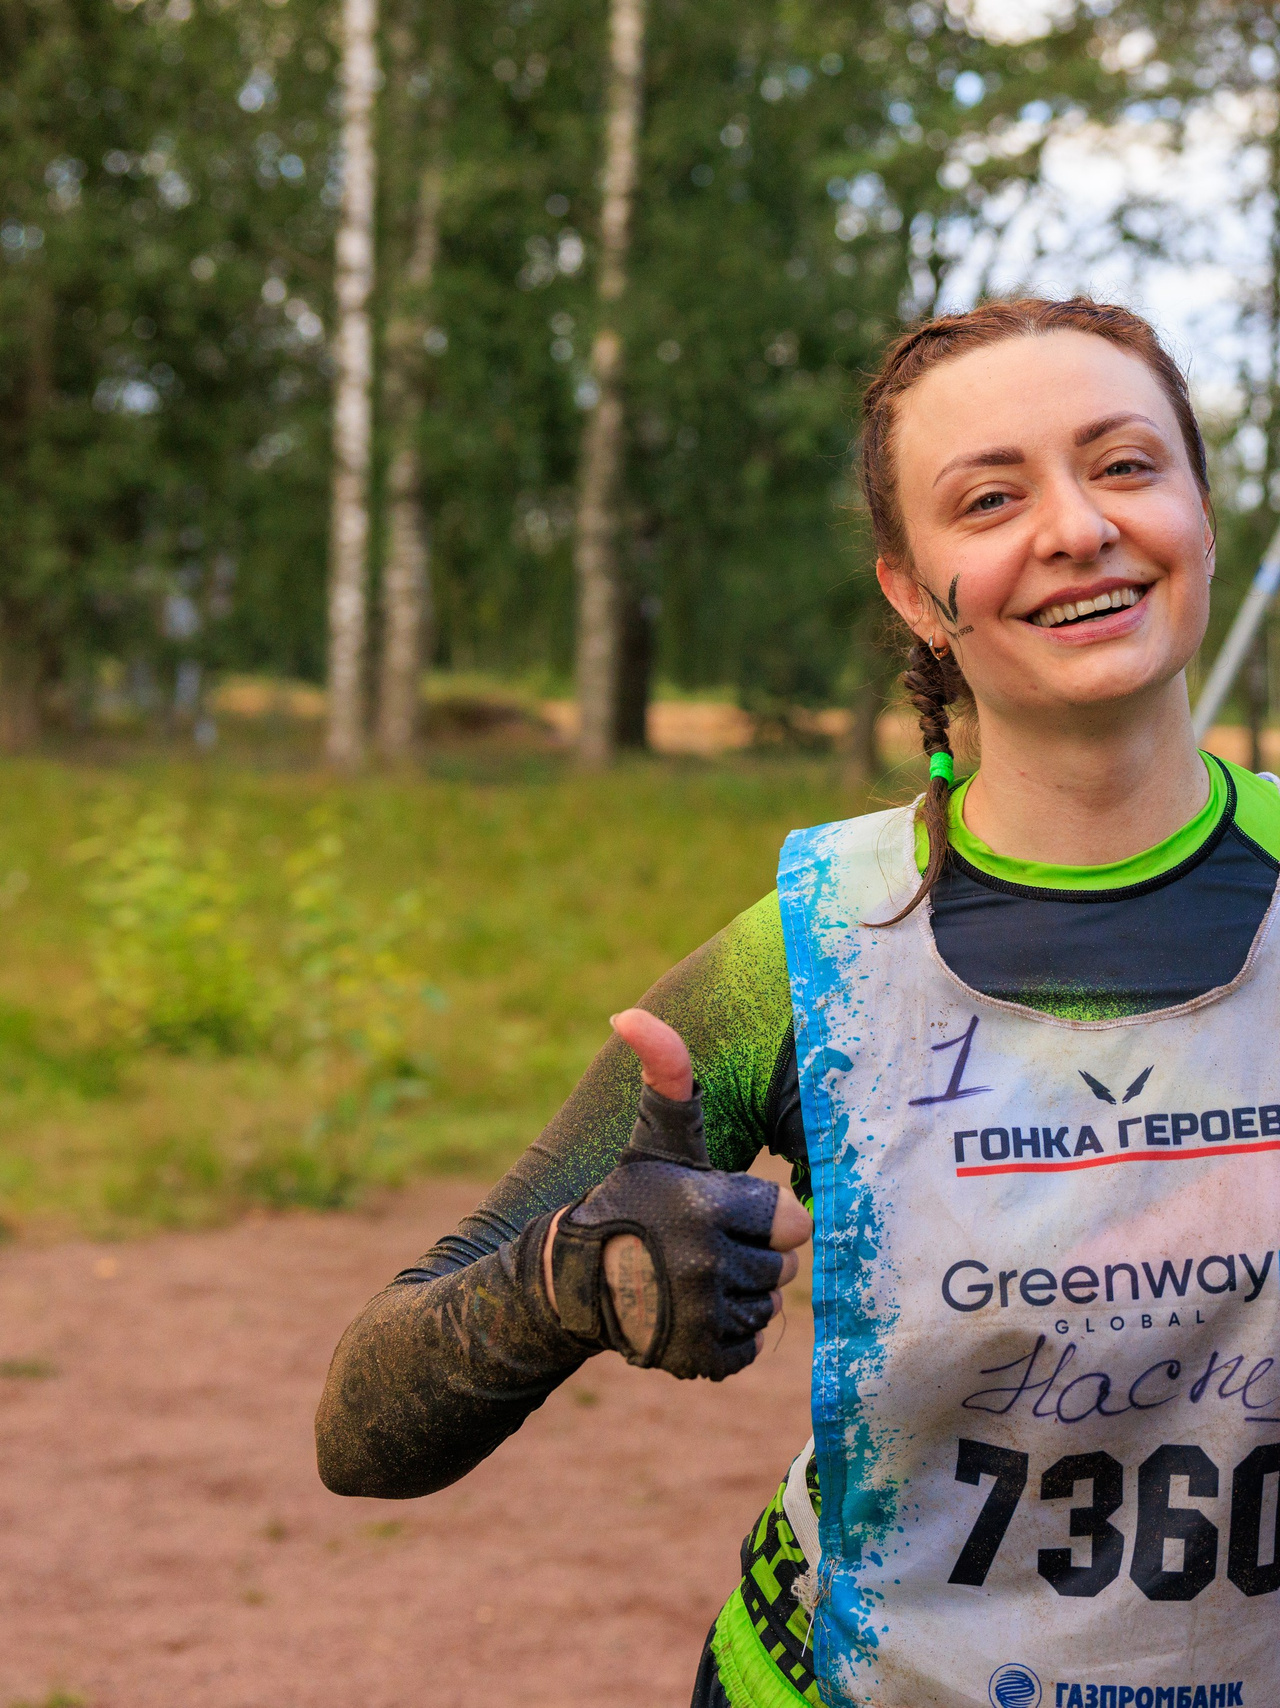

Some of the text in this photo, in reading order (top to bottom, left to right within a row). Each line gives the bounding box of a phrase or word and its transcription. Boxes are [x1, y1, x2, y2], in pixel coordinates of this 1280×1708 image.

[907, 1013, 995, 1106] 1
[953, 1125, 1104, 1163] ГОНКА
[941, 1250, 1275, 1312] Greenway
[1054, 1310, 1206, 1334] GLOBAL
[1055, 1681, 1244, 1708] ГАЗПРОМБАНК
